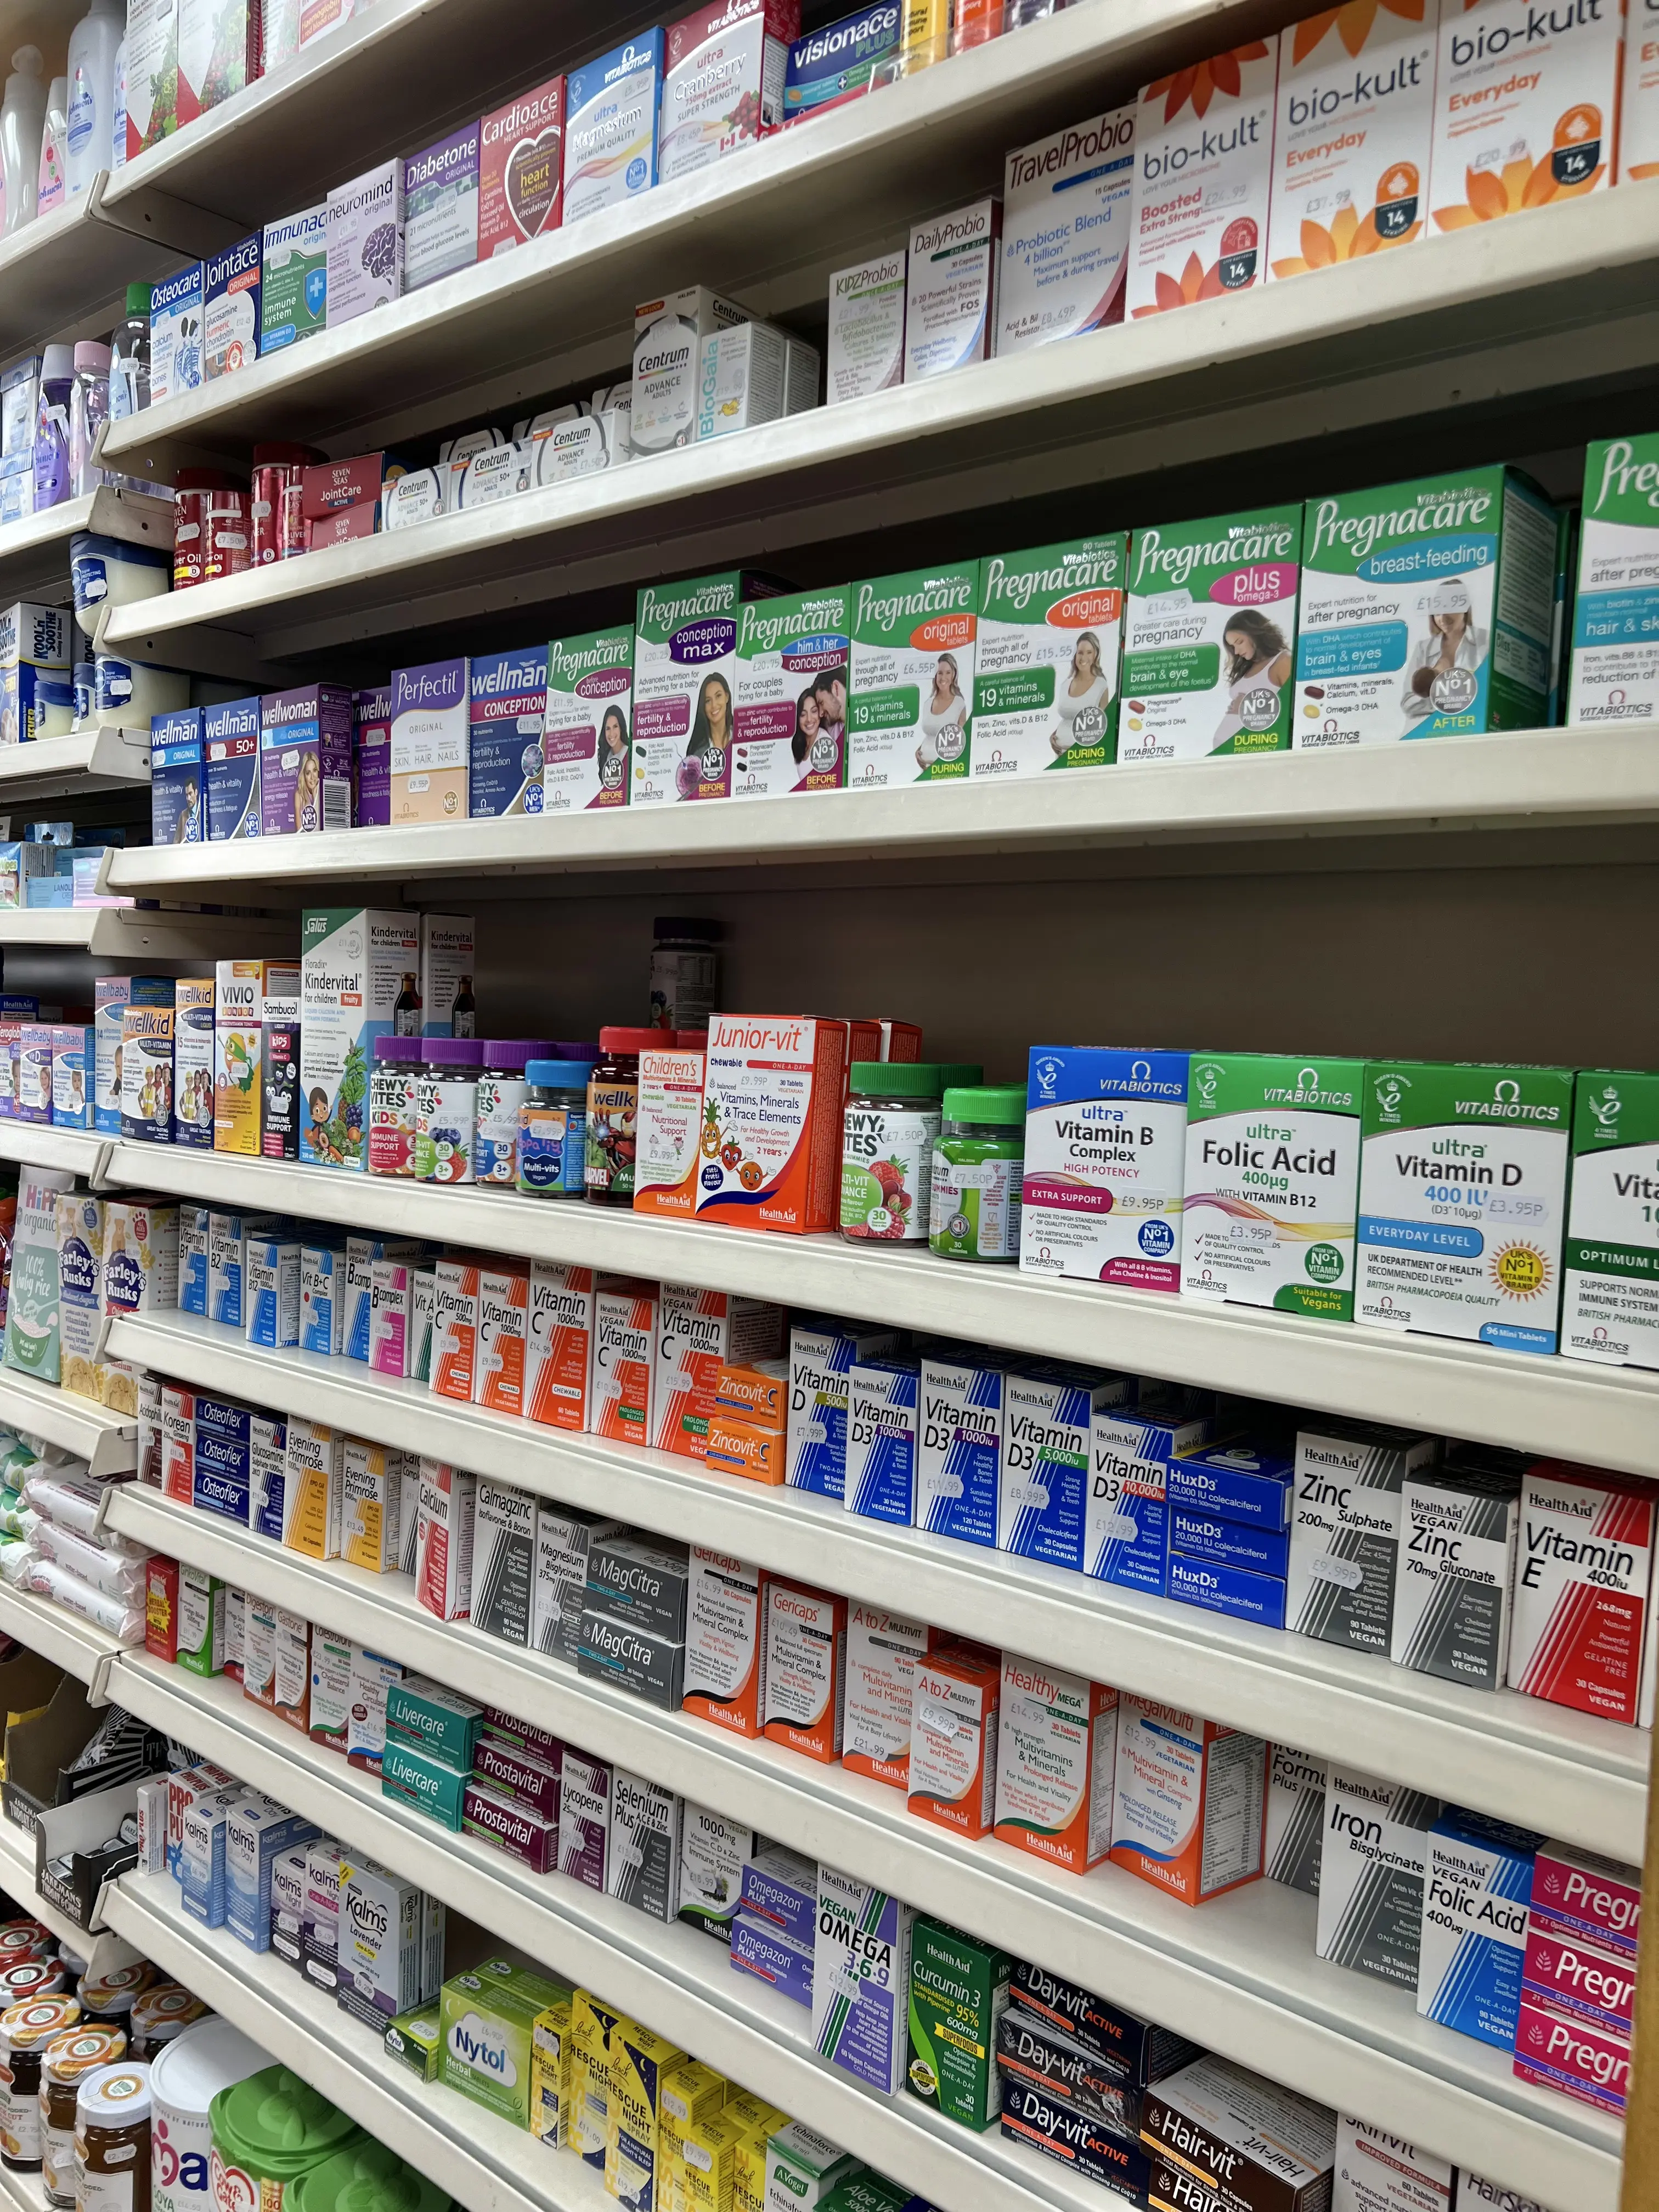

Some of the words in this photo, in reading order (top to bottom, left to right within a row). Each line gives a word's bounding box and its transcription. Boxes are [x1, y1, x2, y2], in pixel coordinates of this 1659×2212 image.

[794, 6, 898, 69] visionace
[856, 30, 894, 58] PLUS
[697, 47, 723, 69] ultra
[674, 53, 747, 101] Cranberry
[483, 91, 558, 146] Cardioace
[573, 106, 642, 153] Magnesium
[1011, 113, 1133, 189] TravelProbio
[1144, 116, 1260, 180] bio-kult
[1286, 131, 1366, 167] Everyday
[407, 139, 476, 187] Diabetone
[521, 163, 549, 185] heart
[328, 175, 393, 222] neuromind
[1142, 188, 1202, 222] Boosted
[915, 214, 985, 253] DailyProbio
[1016, 225, 1070, 254] Probiotic
[1075, 209, 1111, 234] Blend
[205, 243, 258, 294] Jointace
[836, 263, 898, 296] KIDZProbio
[151, 268, 201, 311] Osteocare
[174, 295, 200, 314] ORIGINAL
[206, 304, 238, 328] glucosamine
[264, 296, 296, 314] immune
[961, 300, 979, 312] FOS
[264, 308, 292, 326] system
[639, 346, 690, 373] Centrum
[644, 376, 681, 394] ADVANCE
[699, 340, 719, 438] BioGaia
[554, 427, 590, 447] Centrum
[332, 468, 351, 477] SEVEN
[320, 485, 362, 501] JointCare
[218, 536, 244, 545] £7.50P
[1309, 498, 1491, 562] Pregnacare
[1134, 531, 1292, 589] Pregnacare
[1371, 544, 1488, 576] breast-feeding
[1234, 568, 1280, 601] plus
[855, 583, 970, 635] Pregnacare
[1147, 599, 1187, 615] £14.95
[1307, 610, 1333, 624] after
[1336, 602, 1399, 620] pregnancy
[1417, 595, 1467, 611] £15.95
[676, 625, 732, 644] conception
[739, 605, 844, 653] Pregnacare
[683, 641, 724, 658] max
[550, 641, 629, 683] Pregnacare
[789, 653, 841, 671] conception
[904, 662, 935, 675] £6.55P
[398, 673, 456, 710] Perfectil
[263, 699, 317, 725] wellwoman
[484, 696, 545, 717] CONCEPTION
[871, 701, 904, 712] vitamins
[409, 723, 443, 734] ORIGINAL
[1433, 715, 1475, 729] AFTER
[236, 741, 255, 753] 50+
[1234, 734, 1278, 746] DURING
[305, 917, 327, 935] Salus
[305, 973, 358, 991] Kindervital
[223, 987, 254, 1004] VIVIO
[264, 1001, 297, 1015] Sambucol
[125, 1013, 169, 1035] wellkid
[712, 1022, 802, 1052] Junior-vit
[642, 1056, 696, 1076] Children's
[741, 1075, 768, 1086] £9.99P
[1099, 1079, 1182, 1094] VITABIOTICS
[760, 1095, 799, 1109] Minerals
[1455, 1101, 1559, 1120] VITABIOTICS
[267, 1122, 291, 1132] SUPPORT
[268, 1115, 290, 1124] IMMUNE
[439, 1116, 469, 1125] £5.99P
[652, 1115, 687, 1126] Nutritional
[732, 1107, 757, 1121] Trace
[759, 1110, 801, 1124] Elements
[887, 1130, 923, 1142] £7.50P
[1056, 1120, 1133, 1143] Vitamin
[1141, 1126, 1153, 1145] B
[1069, 1144, 1136, 1163] Complex
[1203, 1139, 1264, 1170] Folic
[1272, 1146, 1336, 1176] Acid
[524, 1163, 559, 1173] Multi-vits
[1396, 1154, 1493, 1185] Vitamin
[1502, 1164, 1522, 1186] D
[1243, 1171, 1289, 1190] 400µg
[1032, 1189, 1059, 1200] EXTRA
[1061, 1193, 1102, 1205] SUPPORT
[1243, 1191, 1286, 1205] VITAMIN
[1290, 1194, 1316, 1208] B12
[1062, 1215, 1075, 1224] HIGH
[1077, 1217, 1107, 1227] STANDARDS
[1230, 1224, 1272, 1240] £3.95P
[180, 1227, 204, 1246] Vitamin
[1369, 1225, 1429, 1243] EVERYDAY
[1433, 1233, 1471, 1248] LEVEL
[58, 1250, 100, 1277] Farley's
[1380, 1255, 1435, 1269] DEPARTMENT
[1436, 1263, 1447, 1272] OF
[1449, 1265, 1482, 1277] HEALTH
[1580, 1249, 1647, 1268] OPTIMUM
[63, 1270, 91, 1287] Rusks
[380, 1290, 404, 1305] complex
[533, 1285, 585, 1316] Vitamin
[1302, 1297, 1341, 1311] Vegans
[557, 1313, 584, 1328] 1000mg
[554, 1386, 580, 1397] CHEWABLE
[204, 1403, 241, 1428] Osteoflex
[926, 1397, 996, 1433] Vitamin
[289, 1432, 321, 1456] Evening
[924, 1425, 950, 1451] D3
[961, 1430, 993, 1446] 1000iu
[252, 1442, 284, 1464] Glucosamine
[289, 1447, 323, 1470] Primrose
[1170, 1469, 1216, 1491] HuxD3
[1299, 1474, 1351, 1509] Zinc
[480, 1485, 531, 1520] Calmagzinc
[1011, 1487, 1045, 1503] £8.99P
[1209, 1493, 1261, 1513] colecalciferol
[951, 1523, 992, 1538] VEGETARIAN
[1338, 1509, 1392, 1532] Sulphate
[1037, 1525, 1078, 1541] Cholecalciferol
[540, 1542, 584, 1568] Magnesium
[1526, 1522, 1634, 1576] Vitamin
[599, 1556, 661, 1598] MagCitra
[1311, 1560, 1357, 1581] £9.99P
[1440, 1560, 1496, 1584] Gluconate
[1587, 1570, 1628, 1591] 400iu
[774, 1593, 819, 1622] Gericaps
[889, 1622, 922, 1638] MULTIVIT
[1005, 1664, 1058, 1703] Healthy
[396, 1700, 445, 1737] Livercare
[855, 1737, 884, 1755] £21.99
[1015, 1736, 1073, 1767] Multivitamins
[484, 1752, 543, 1796] Prostavital
[563, 1782, 603, 1814] Lycopene
[616, 1780, 669, 1821] Selenium
[1156, 1791, 1182, 1809] Ginseng
[1330, 1804, 1382, 1844] Iron
[228, 1820, 255, 1853] kalms
[1350, 1839, 1424, 1873] Bisglycinate
[41, 1869, 82, 1908] JAKEMANS
[749, 1875, 801, 1912] Omegazon
[347, 1892, 388, 1937] Kalms
[820, 1894, 856, 1925] VEGAN
[1429, 1880, 1473, 1918] Folic
[1482, 1899, 1527, 1936] Acid
[350, 1927, 382, 1950] Lavender
[819, 1912, 891, 1968] OMEGA
[913, 1961, 970, 2000] Curcumin
[1028, 1966, 1090, 2022] Day-vit
[1085, 2010, 1123, 2039] ACTIVE
[455, 2028, 505, 2073] Nytol
[943, 2030, 978, 2055] SUPERFOODS
[446, 2056, 471, 2078] Herbal
[623, 2106, 651, 2134] NIGHT
[627, 2123, 651, 2144] SPRAY
[792, 2124, 836, 2155] Echinaforce
[1162, 2111, 1237, 2181] Hair-vit
